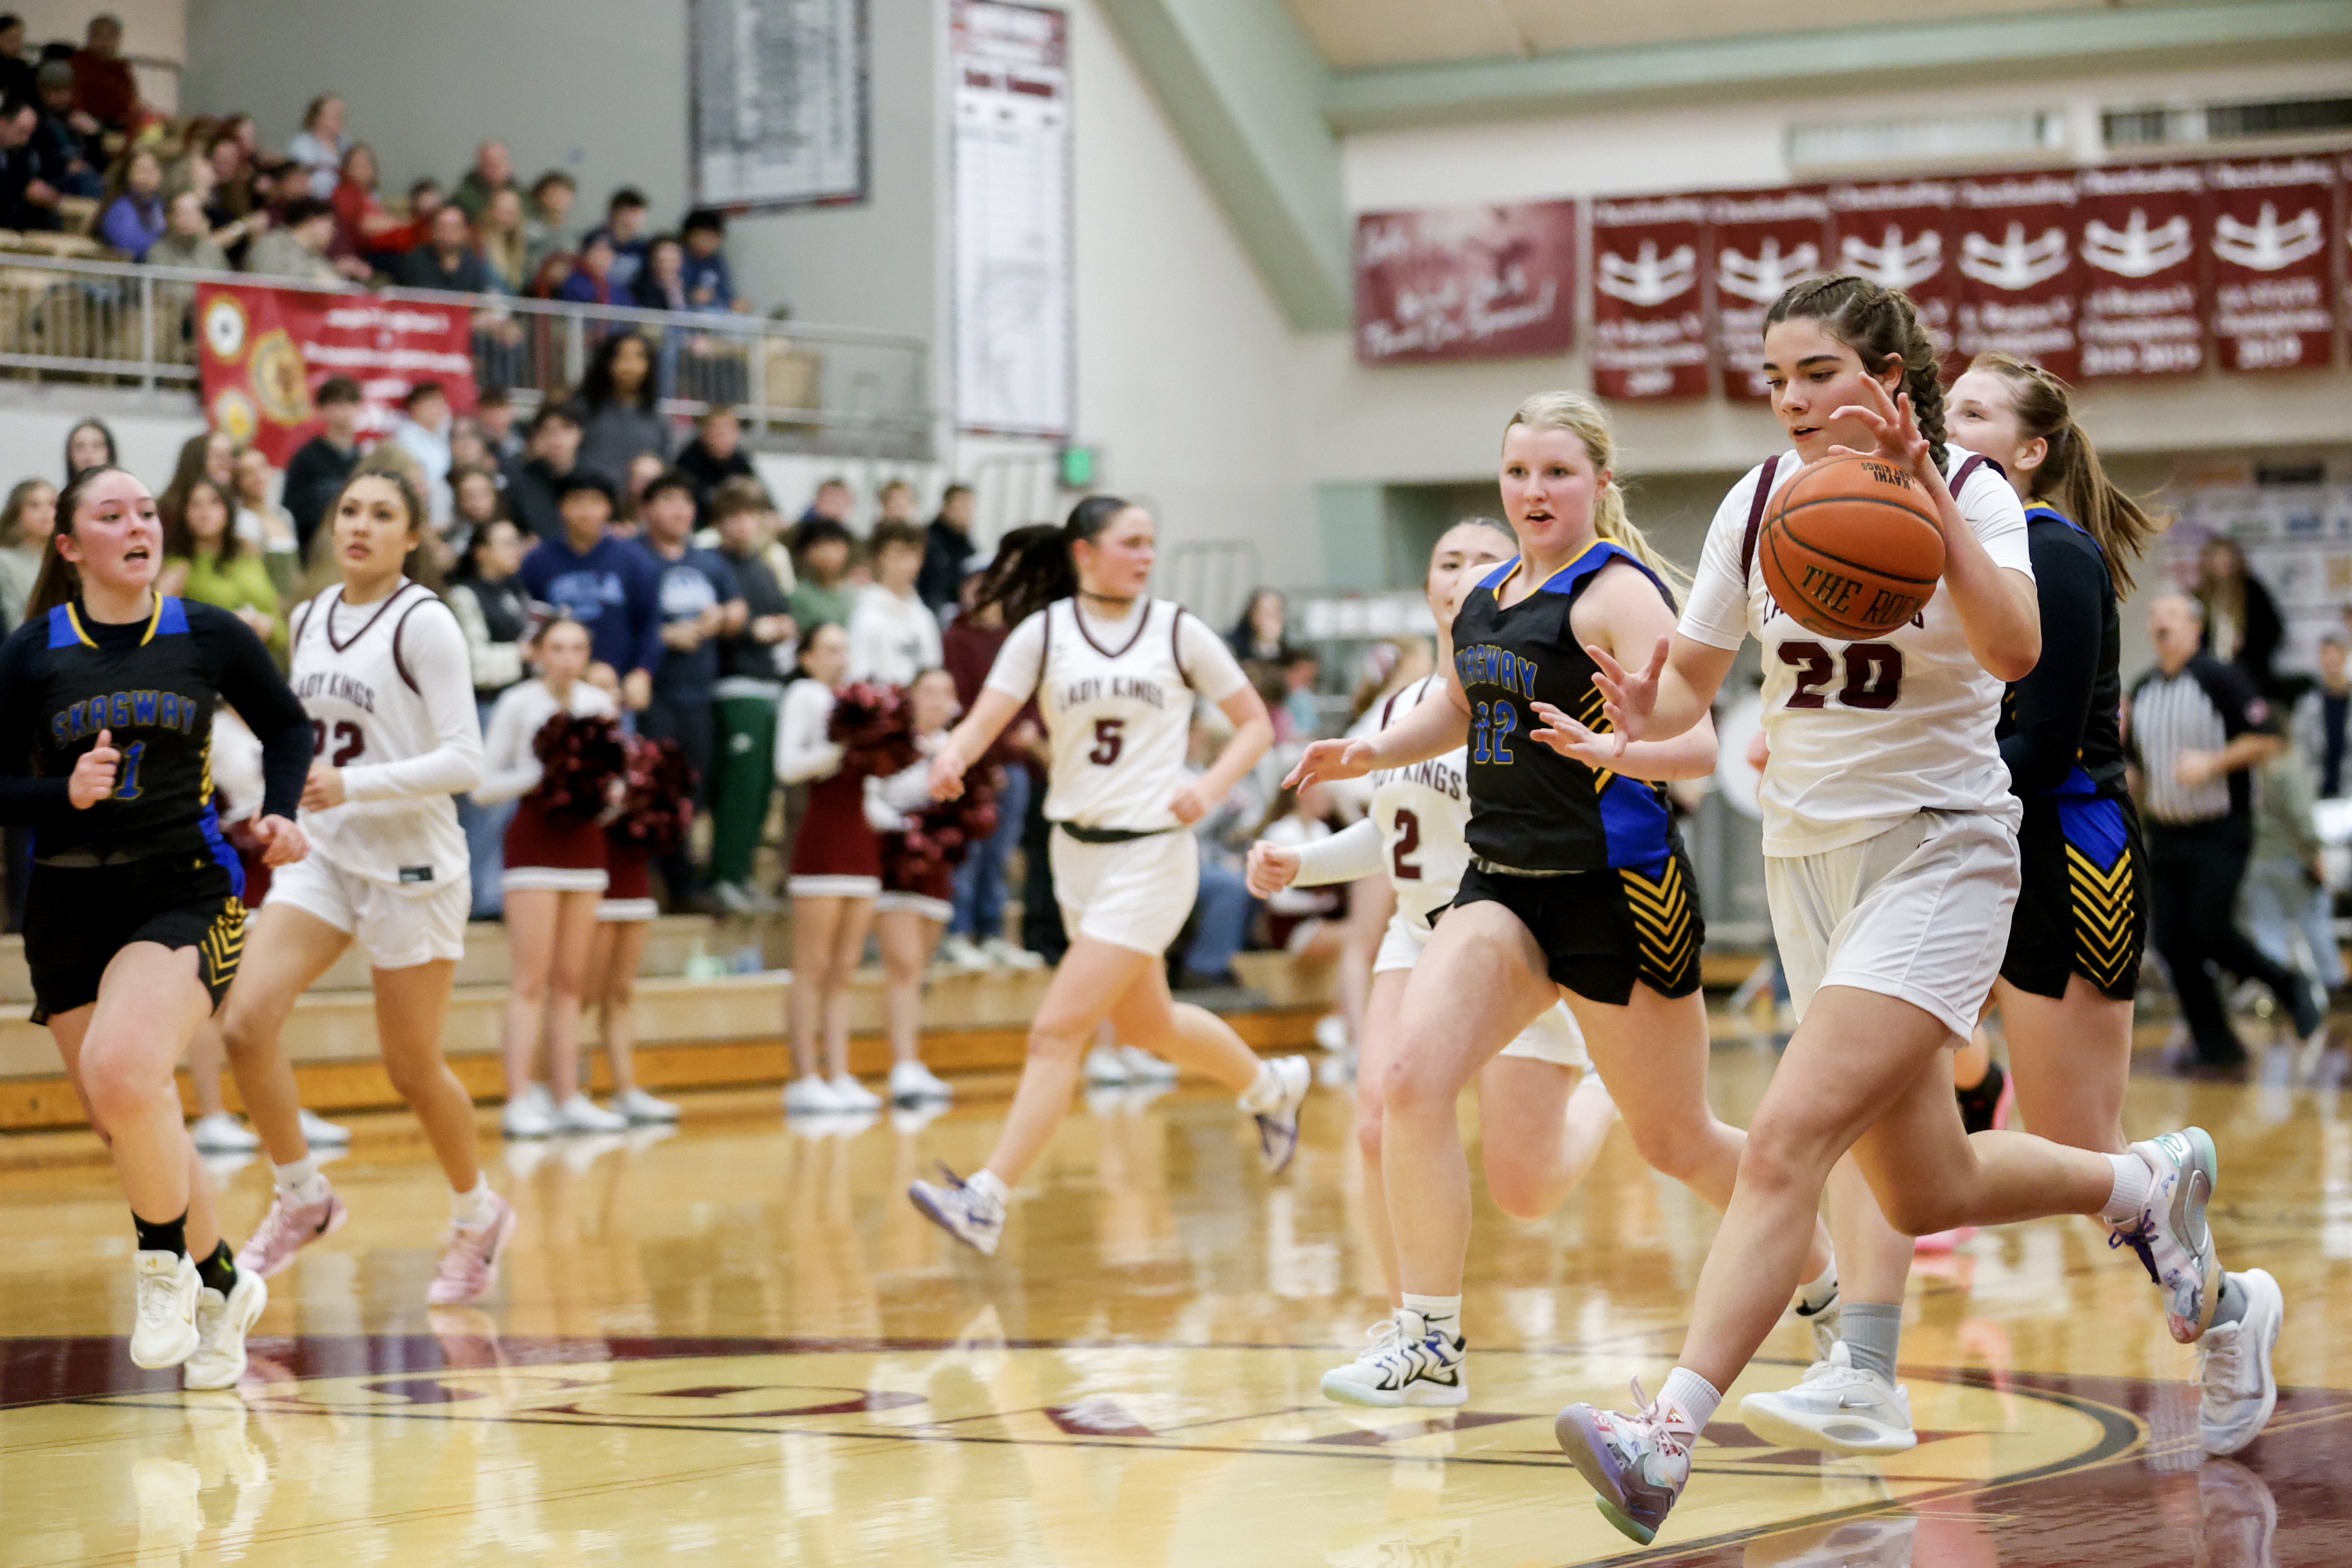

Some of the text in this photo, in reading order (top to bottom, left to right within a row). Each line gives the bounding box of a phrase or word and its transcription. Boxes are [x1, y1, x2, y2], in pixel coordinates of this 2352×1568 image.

[1873, 471, 1911, 490] KAYHI
[1800, 564, 1863, 614] THE
[297, 671, 375, 714] ADY KINGS
[1059, 676, 1165, 714] LADY KINGS
[1455, 644, 1538, 700] KAGWAY
[1776, 638, 1905, 711] 20
[52, 689, 197, 750] SKAGWAY
[1089, 719, 1125, 766] 5
[1473, 699, 1518, 765] 12
[1403, 758, 1461, 801] KINGS
[1394, 808, 1422, 880] 2
